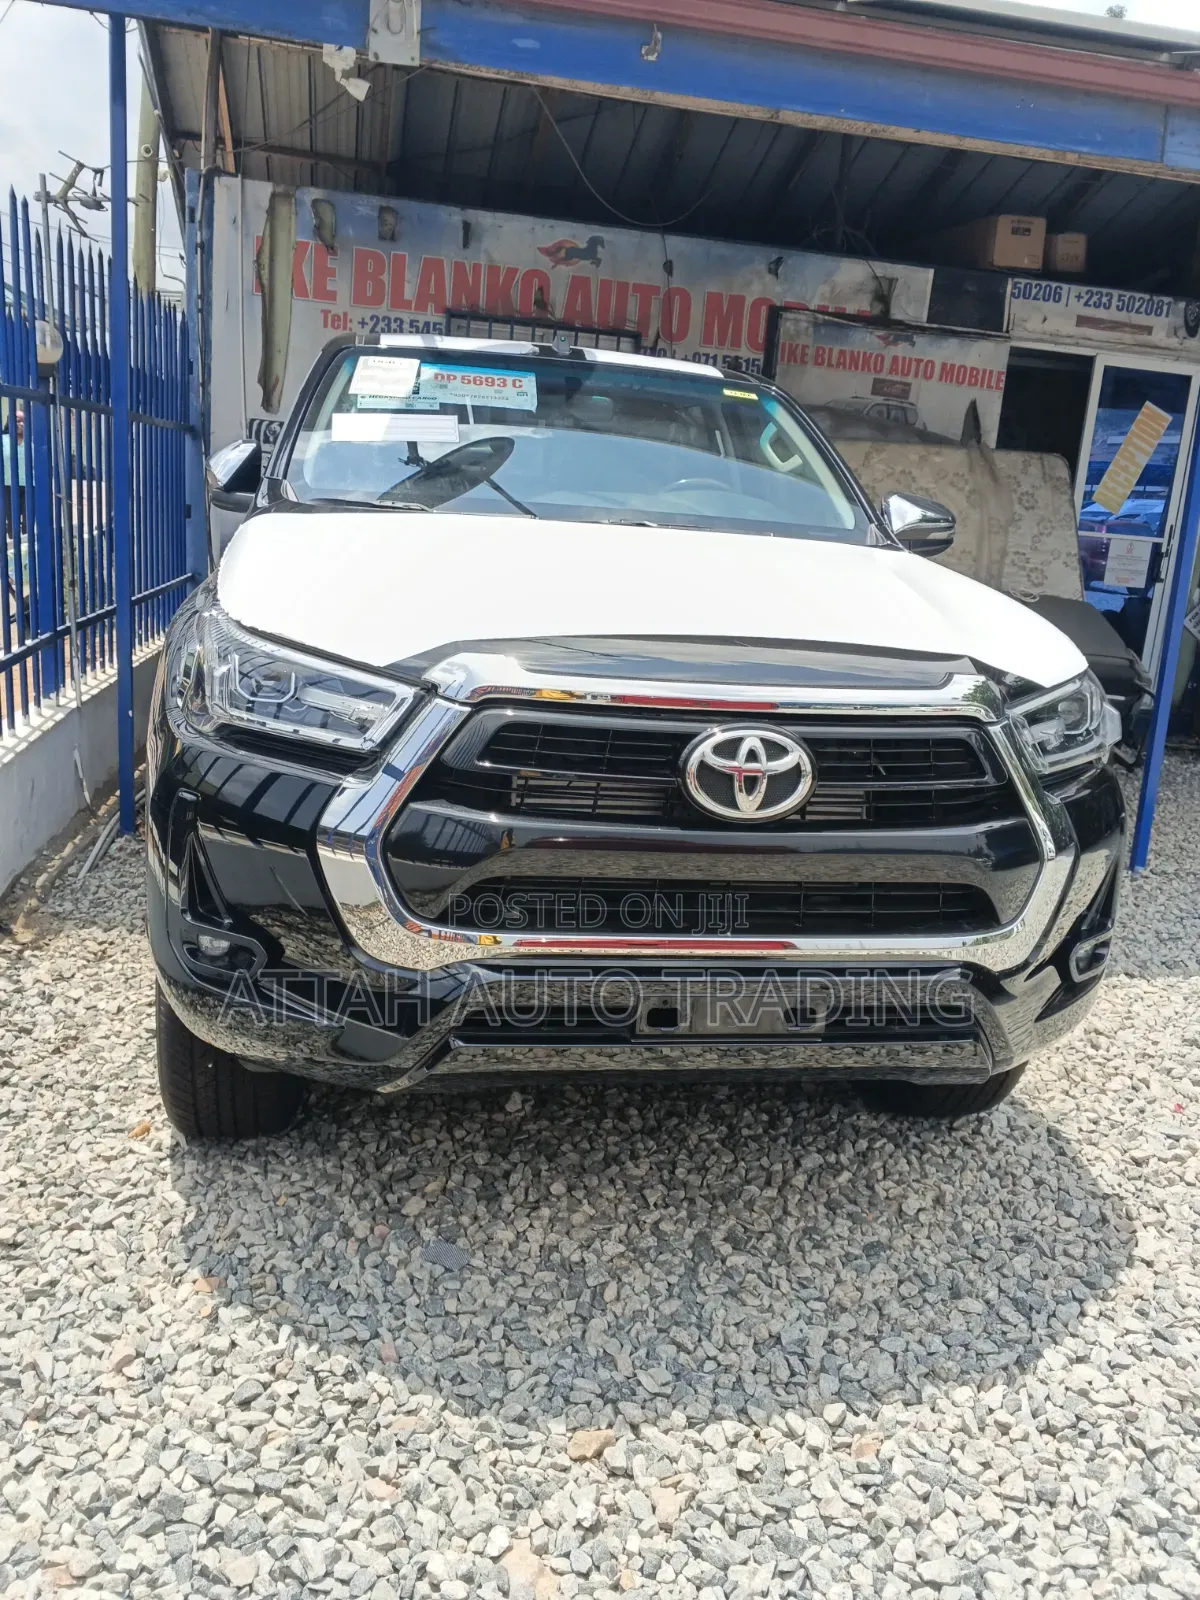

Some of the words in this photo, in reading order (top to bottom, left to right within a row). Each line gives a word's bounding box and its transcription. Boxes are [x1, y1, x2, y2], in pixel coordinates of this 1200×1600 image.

[351, 247, 551, 318] BLANKO
[562, 274, 692, 344] AUTO
[1012, 281, 1063, 303] 50206
[1074, 289, 1114, 311] +233
[1116, 294, 1173, 318] 502081
[320, 308, 353, 332] Tel:
[357, 314, 404, 333] +233
[460, 375, 507, 388] 5693
[512, 378, 523, 389] C
[779, 341, 809, 364] IKE
[813, 346, 885, 375] BLANKO
[888, 354, 936, 381] AUTO
[938, 361, 1005, 391] MOBILE
[1093, 402, 1172, 514] RECEPTION
